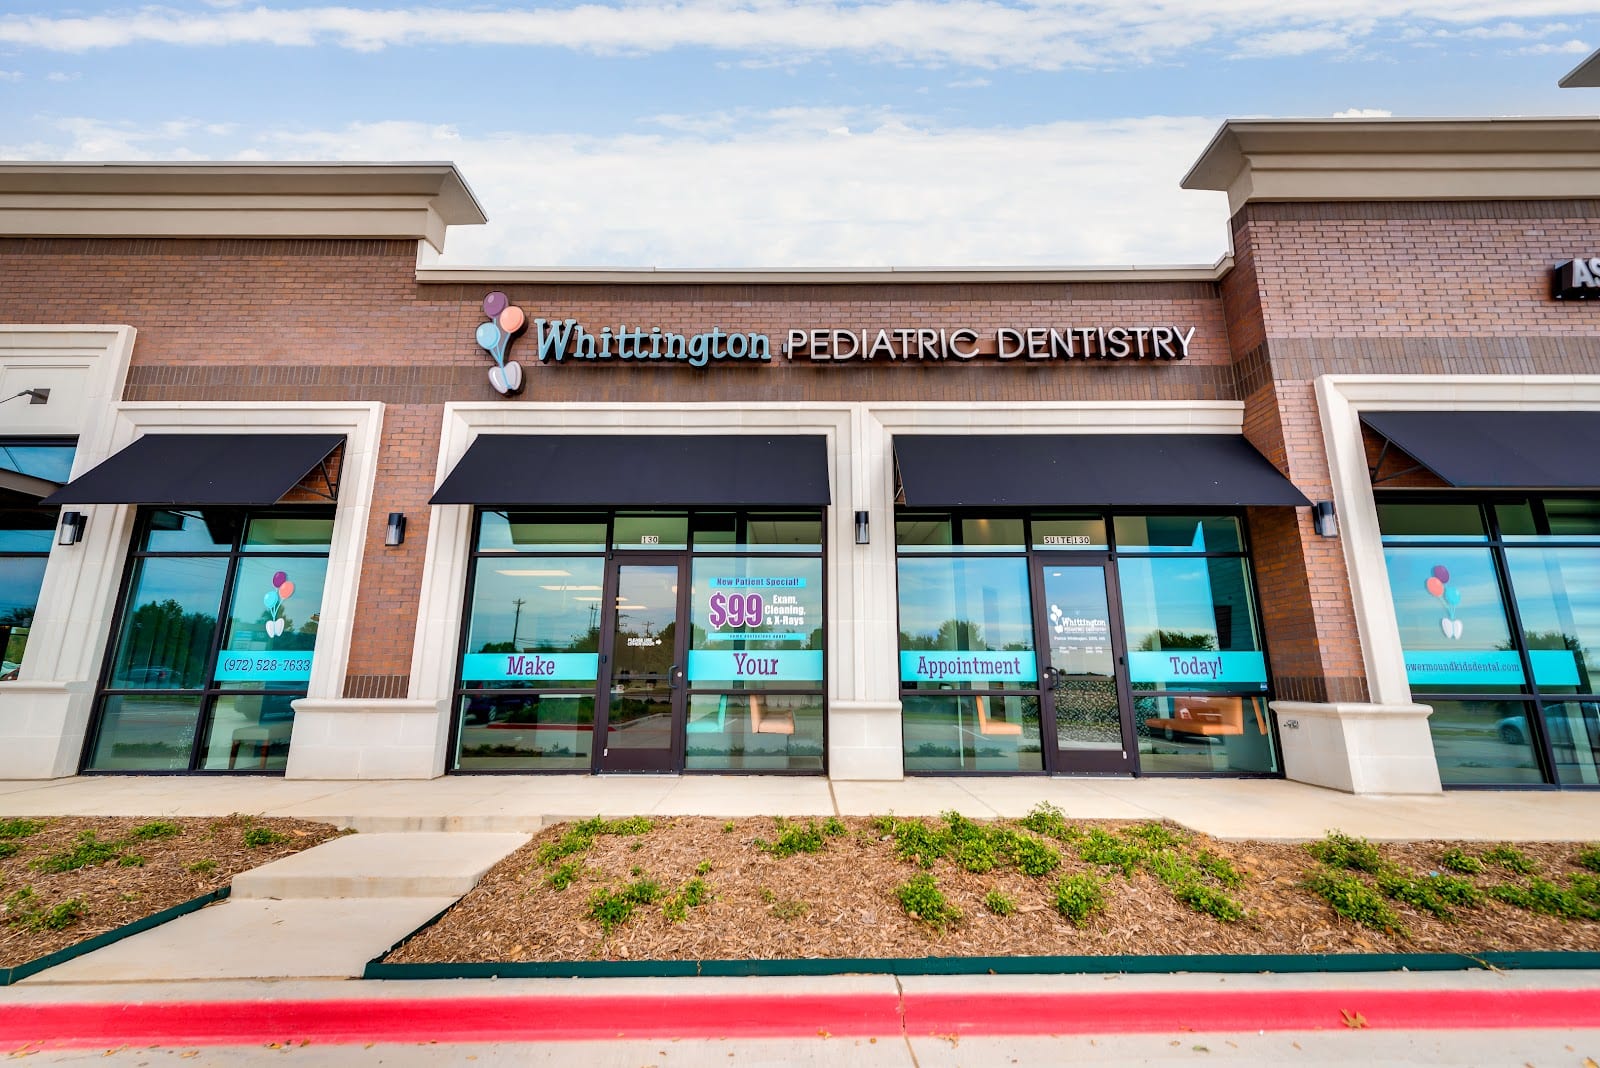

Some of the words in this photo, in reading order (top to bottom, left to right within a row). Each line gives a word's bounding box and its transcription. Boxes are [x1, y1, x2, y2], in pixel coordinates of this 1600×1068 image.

[533, 317, 771, 366] Whittington
[786, 328, 980, 360] PEDIATRIC
[997, 326, 1196, 359] DENTISTRY
[641, 535, 659, 544] 130
[1044, 536, 1072, 544] SUITE
[1073, 536, 1090, 544] 130
[717, 577, 733, 586] New
[735, 577, 764, 586] Patient
[766, 577, 799, 587] Special!
[709, 591, 763, 630] $99
[766, 616, 773, 625] &
[774, 615, 804, 626] X-Rays
[1061, 616, 1106, 628] Whittington
[224, 658, 254, 672] (972)
[256, 659, 311, 671] 528-7633
[506, 655, 555, 676] Make
[733, 652, 779, 675] Your
[917, 656, 1021, 679] Appointment
[1169, 656, 1224, 680] Today!
